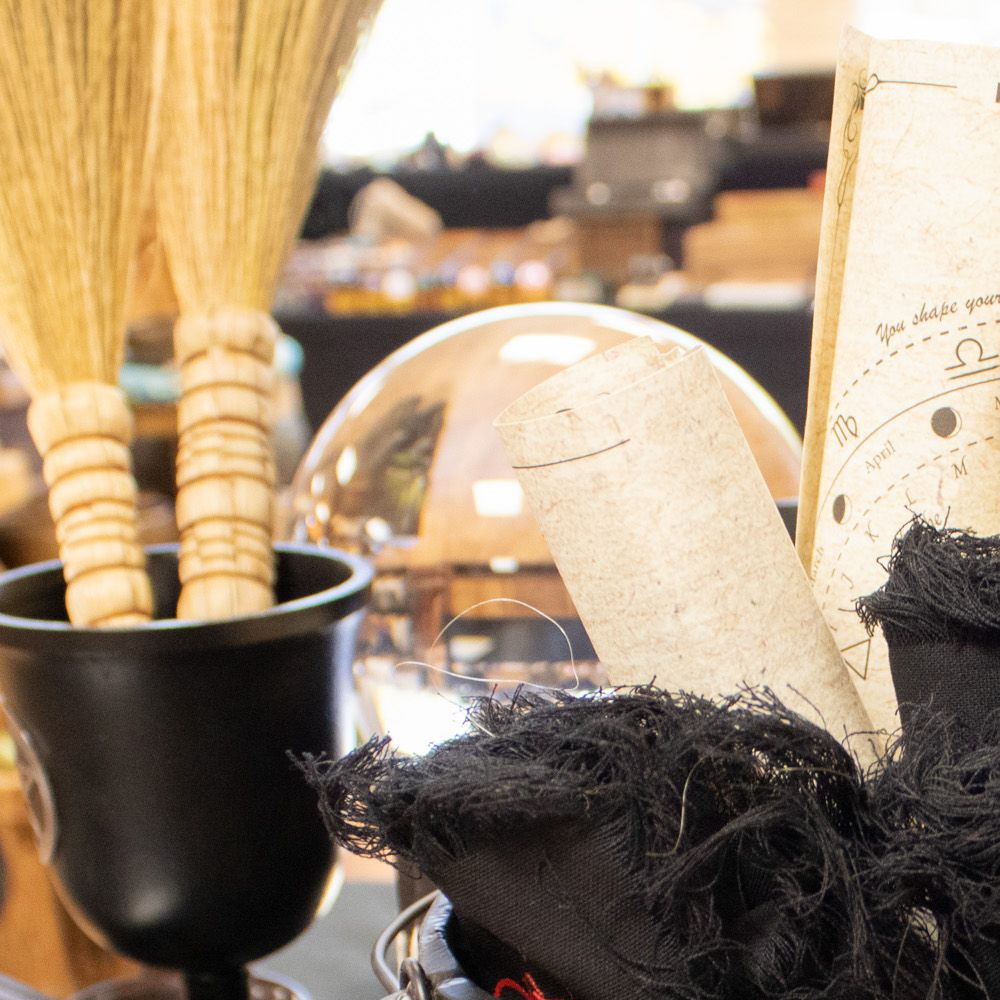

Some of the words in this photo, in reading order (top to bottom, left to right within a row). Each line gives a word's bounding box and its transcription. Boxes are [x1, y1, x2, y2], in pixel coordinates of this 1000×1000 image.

[876, 320, 905, 347] You
[912, 302, 958, 326] shape
[864, 439, 897, 475] April
[953, 455, 968, 479] M
